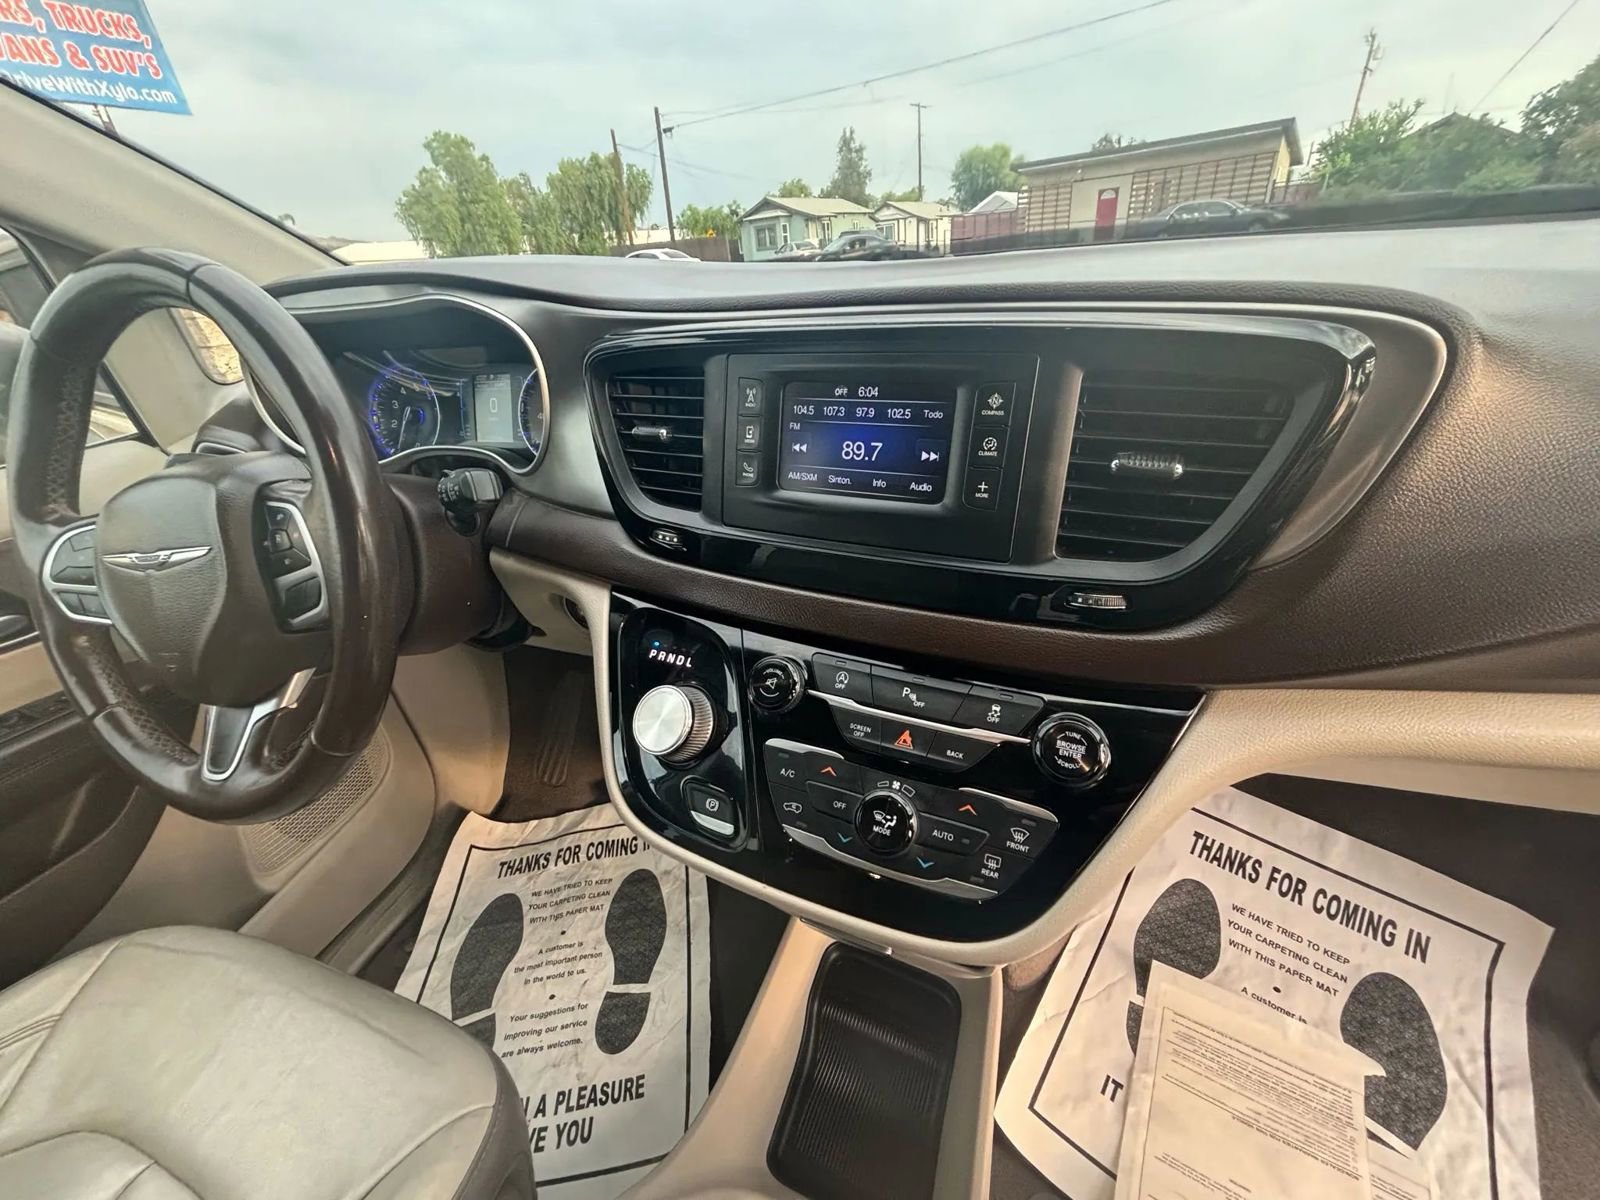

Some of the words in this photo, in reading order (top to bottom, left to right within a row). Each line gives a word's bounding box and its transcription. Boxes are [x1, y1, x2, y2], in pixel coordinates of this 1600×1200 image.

[42, 0, 152, 49] TRUCKS,
[64, 41, 93, 71] &
[91, 45, 163, 79] SUV'S
[858, 386, 879, 397] 6:04
[391, 400, 399, 409] 3
[489, 397, 498, 413] 0
[793, 405, 815, 415] 104.5
[823, 406, 845, 416] 107.3
[856, 407, 875, 417] 97.9
[887, 408, 911, 419] 102.5
[923, 409, 944, 418] Todo
[391, 420, 398, 428] 2
[841, 441, 883, 461] 89.7
[872, 479, 887, 488] Info
[909, 482, 933, 492] Audio
[849, 723, 872, 733] SCREEN
[1065, 731, 1082, 740] TUNE
[1056, 740, 1087, 751] BROWSE
[946, 750, 964, 759] BACK
[1059, 749, 1083, 759] ENTER
[780, 769, 795, 778] A/C
[833, 801, 847, 810] OFF
[872, 825, 891, 836] MODE
[932, 829, 954, 841] AUTO
[1006, 841, 1030, 853] FRONT
[497, 852, 551, 878] THANKS
[554, 844, 580, 866] FOR
[586, 836, 638, 860] COMING
[981, 868, 999, 880] REAR
[544, 887, 561, 895] HAVE
[563, 882, 582, 891] TRIED
[595, 878, 613, 886] KEEP
[528, 900, 548, 911] YOUR
[549, 894, 587, 907] CARPETING
[588, 890, 611, 899] CLEAN
[1189, 830, 1263, 884] THANKS
[1265, 866, 1307, 906] FOR
[1312, 888, 1398, 948] COMING
[1404, 928, 1431, 964] IN
[529, 913, 547, 924] WITH
[549, 912, 564, 922] THIS
[565, 907, 588, 918] PAPER
[589, 904, 605, 912] MAT
[1232, 903, 1247, 916] WE
[1248, 911, 1274, 930] HAVE
[1276, 925, 1304, 944] TRIED
[1306, 939, 1320, 952] TO
[1323, 948, 1351, 965] KEEP
[545, 942, 577, 953] customer
[1228, 919, 1253, 938] YOUR
[1255, 933, 1310, 965] CARPETING
[1313, 961, 1348, 983] CLEAN
[526, 961, 544, 970] most
[545, 955, 578, 967] important
[579, 951, 603, 962] person
[1228, 938, 1252, 956] WITH
[1255, 950, 1276, 967] THIS
[1279, 963, 1313, 985] PAPER
[1316, 981, 1339, 997] MAT
[546, 971, 565, 980] world
[1241, 987, 1249, 995] A
[1251, 992, 1296, 1019] customer
[510, 1013, 528, 1022] Your
[529, 1005, 575, 1019] suggestions
[577, 1002, 589, 1010] for
[504, 1028, 542, 1041] improving
[544, 1025, 558, 1033] our
[560, 1019, 588, 1030] service
[501, 1050, 514, 1058] are
[516, 1044, 544, 1056] always
[546, 1037, 583, 1050] welcome.
[533, 1093, 547, 1119] A
[553, 1074, 646, 1116] PLEASURE
[1100, 1074, 1124, 1103] IT
[556, 1116, 594, 1150] YOU
